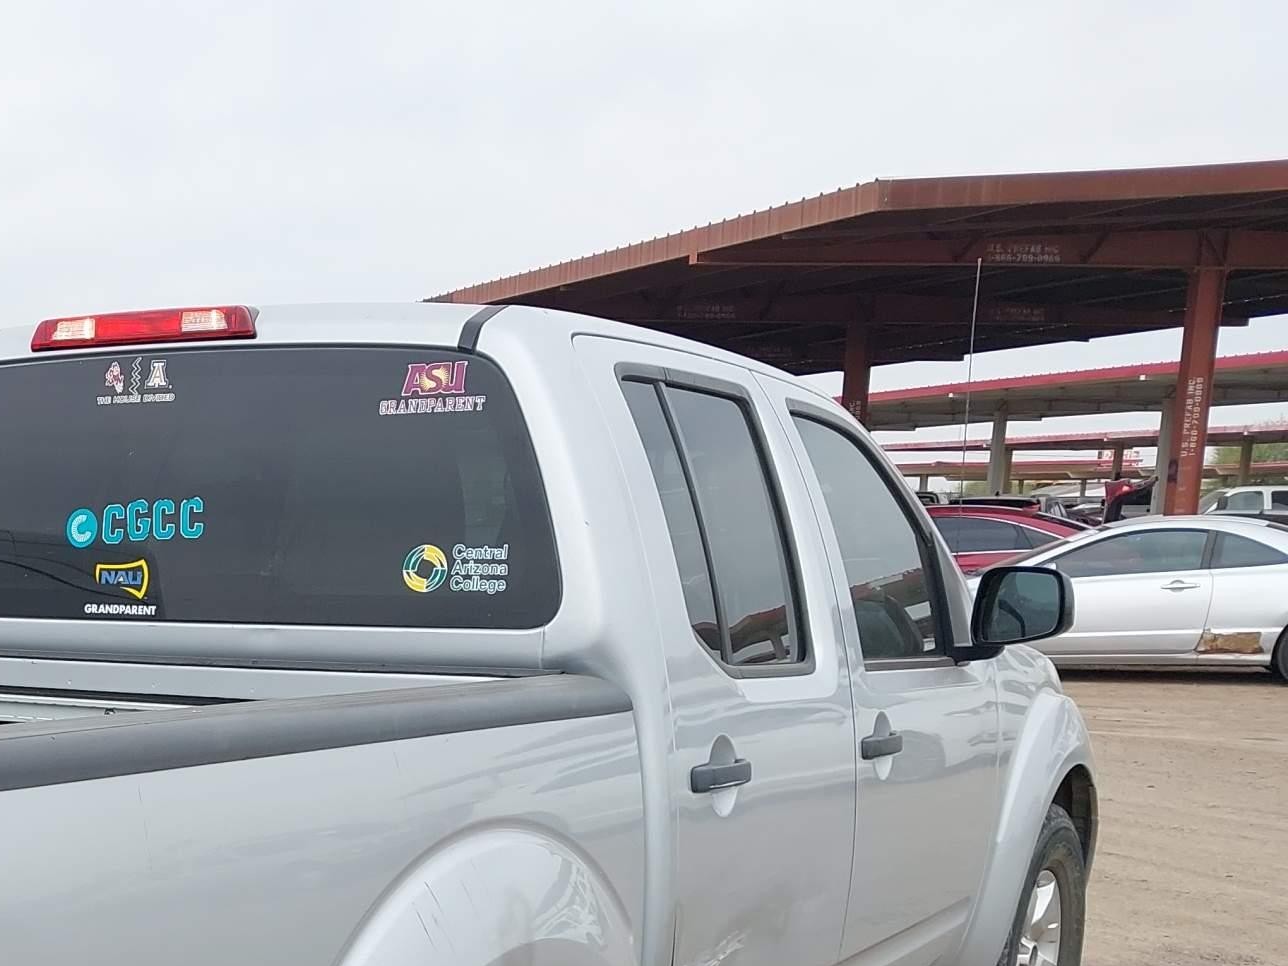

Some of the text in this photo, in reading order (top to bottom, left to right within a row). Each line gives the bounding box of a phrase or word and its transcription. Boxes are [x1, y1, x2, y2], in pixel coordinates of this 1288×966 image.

[402, 361, 468, 396] ASU
[379, 396, 486, 415] GRANDPARENT
[102, 497, 204, 544] CGCC
[452, 543, 508, 560] Central
[451, 560, 508, 576] Arizona
[101, 570, 142, 585] NAU
[450, 575, 506, 595] College
[84, 603, 156, 616] GRANDPARENT
